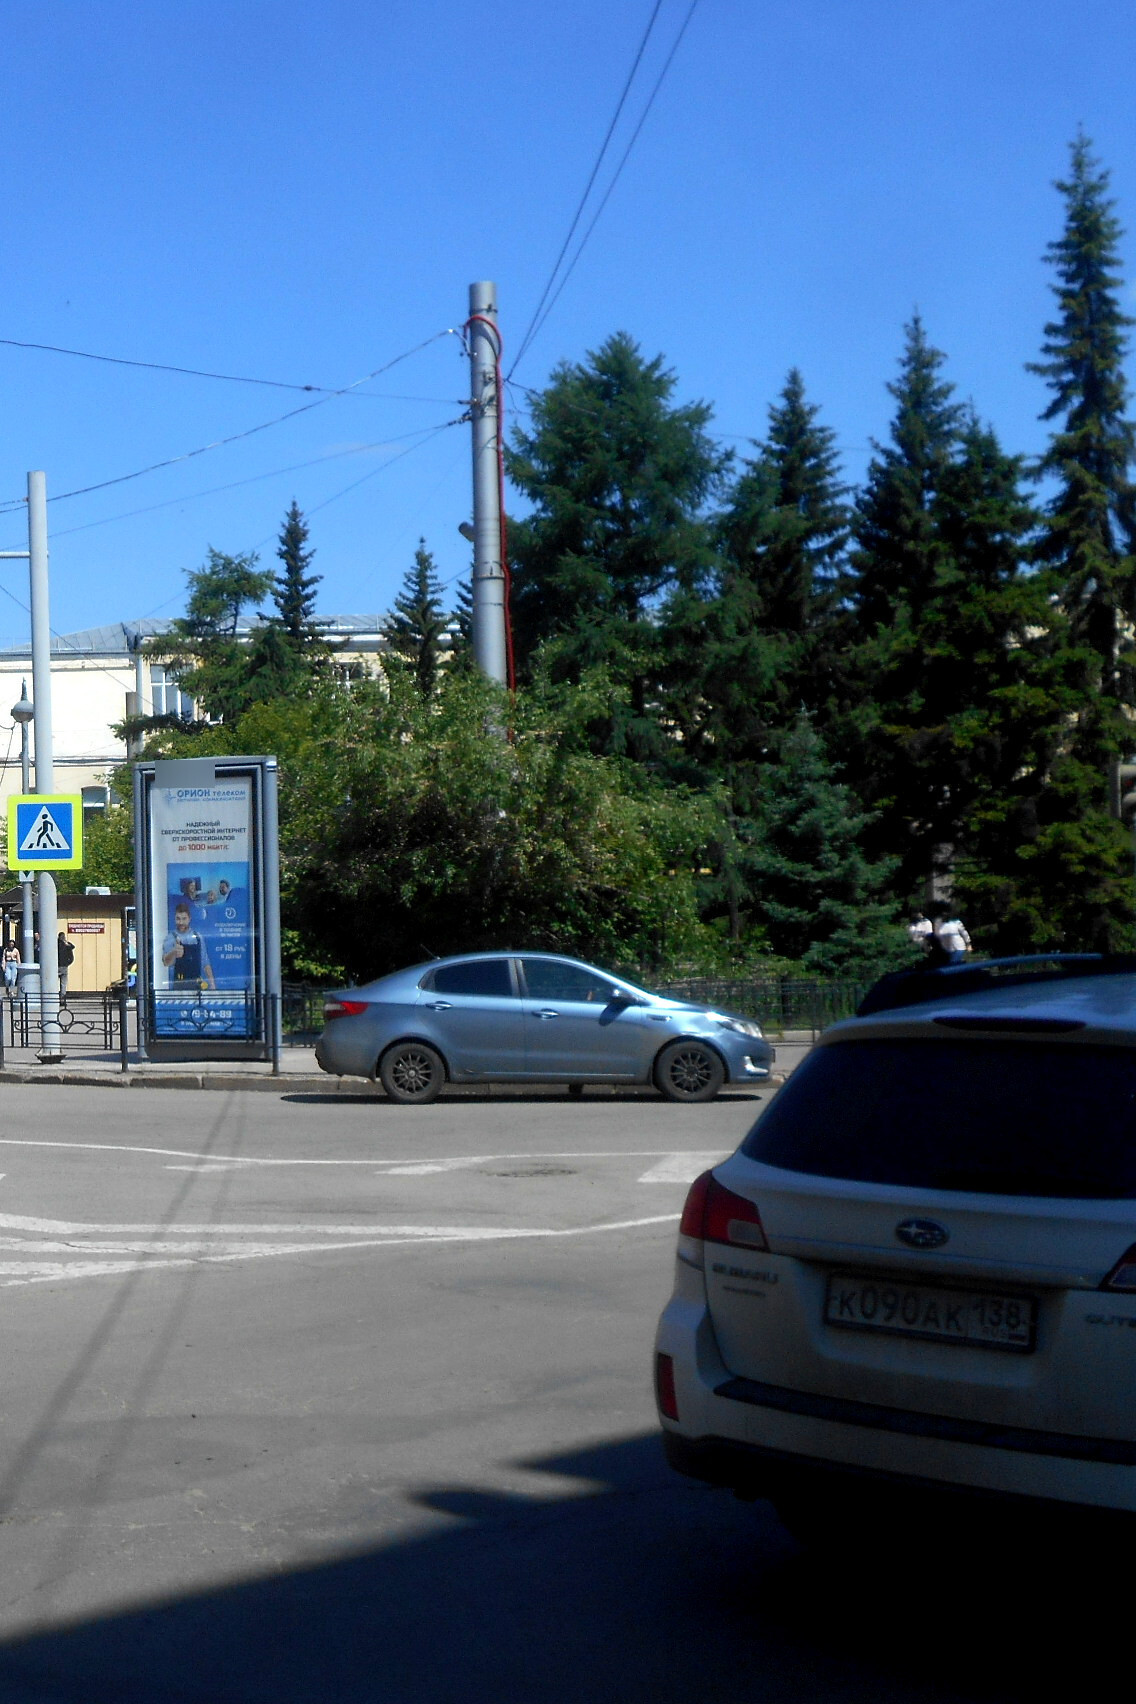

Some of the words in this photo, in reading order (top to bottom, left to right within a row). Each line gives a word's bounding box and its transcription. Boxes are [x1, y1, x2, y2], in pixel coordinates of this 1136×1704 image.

[177, 789, 210, 797] ОРИОН
[187, 843, 206, 851] 1000
[224, 943, 233, 952] 18
